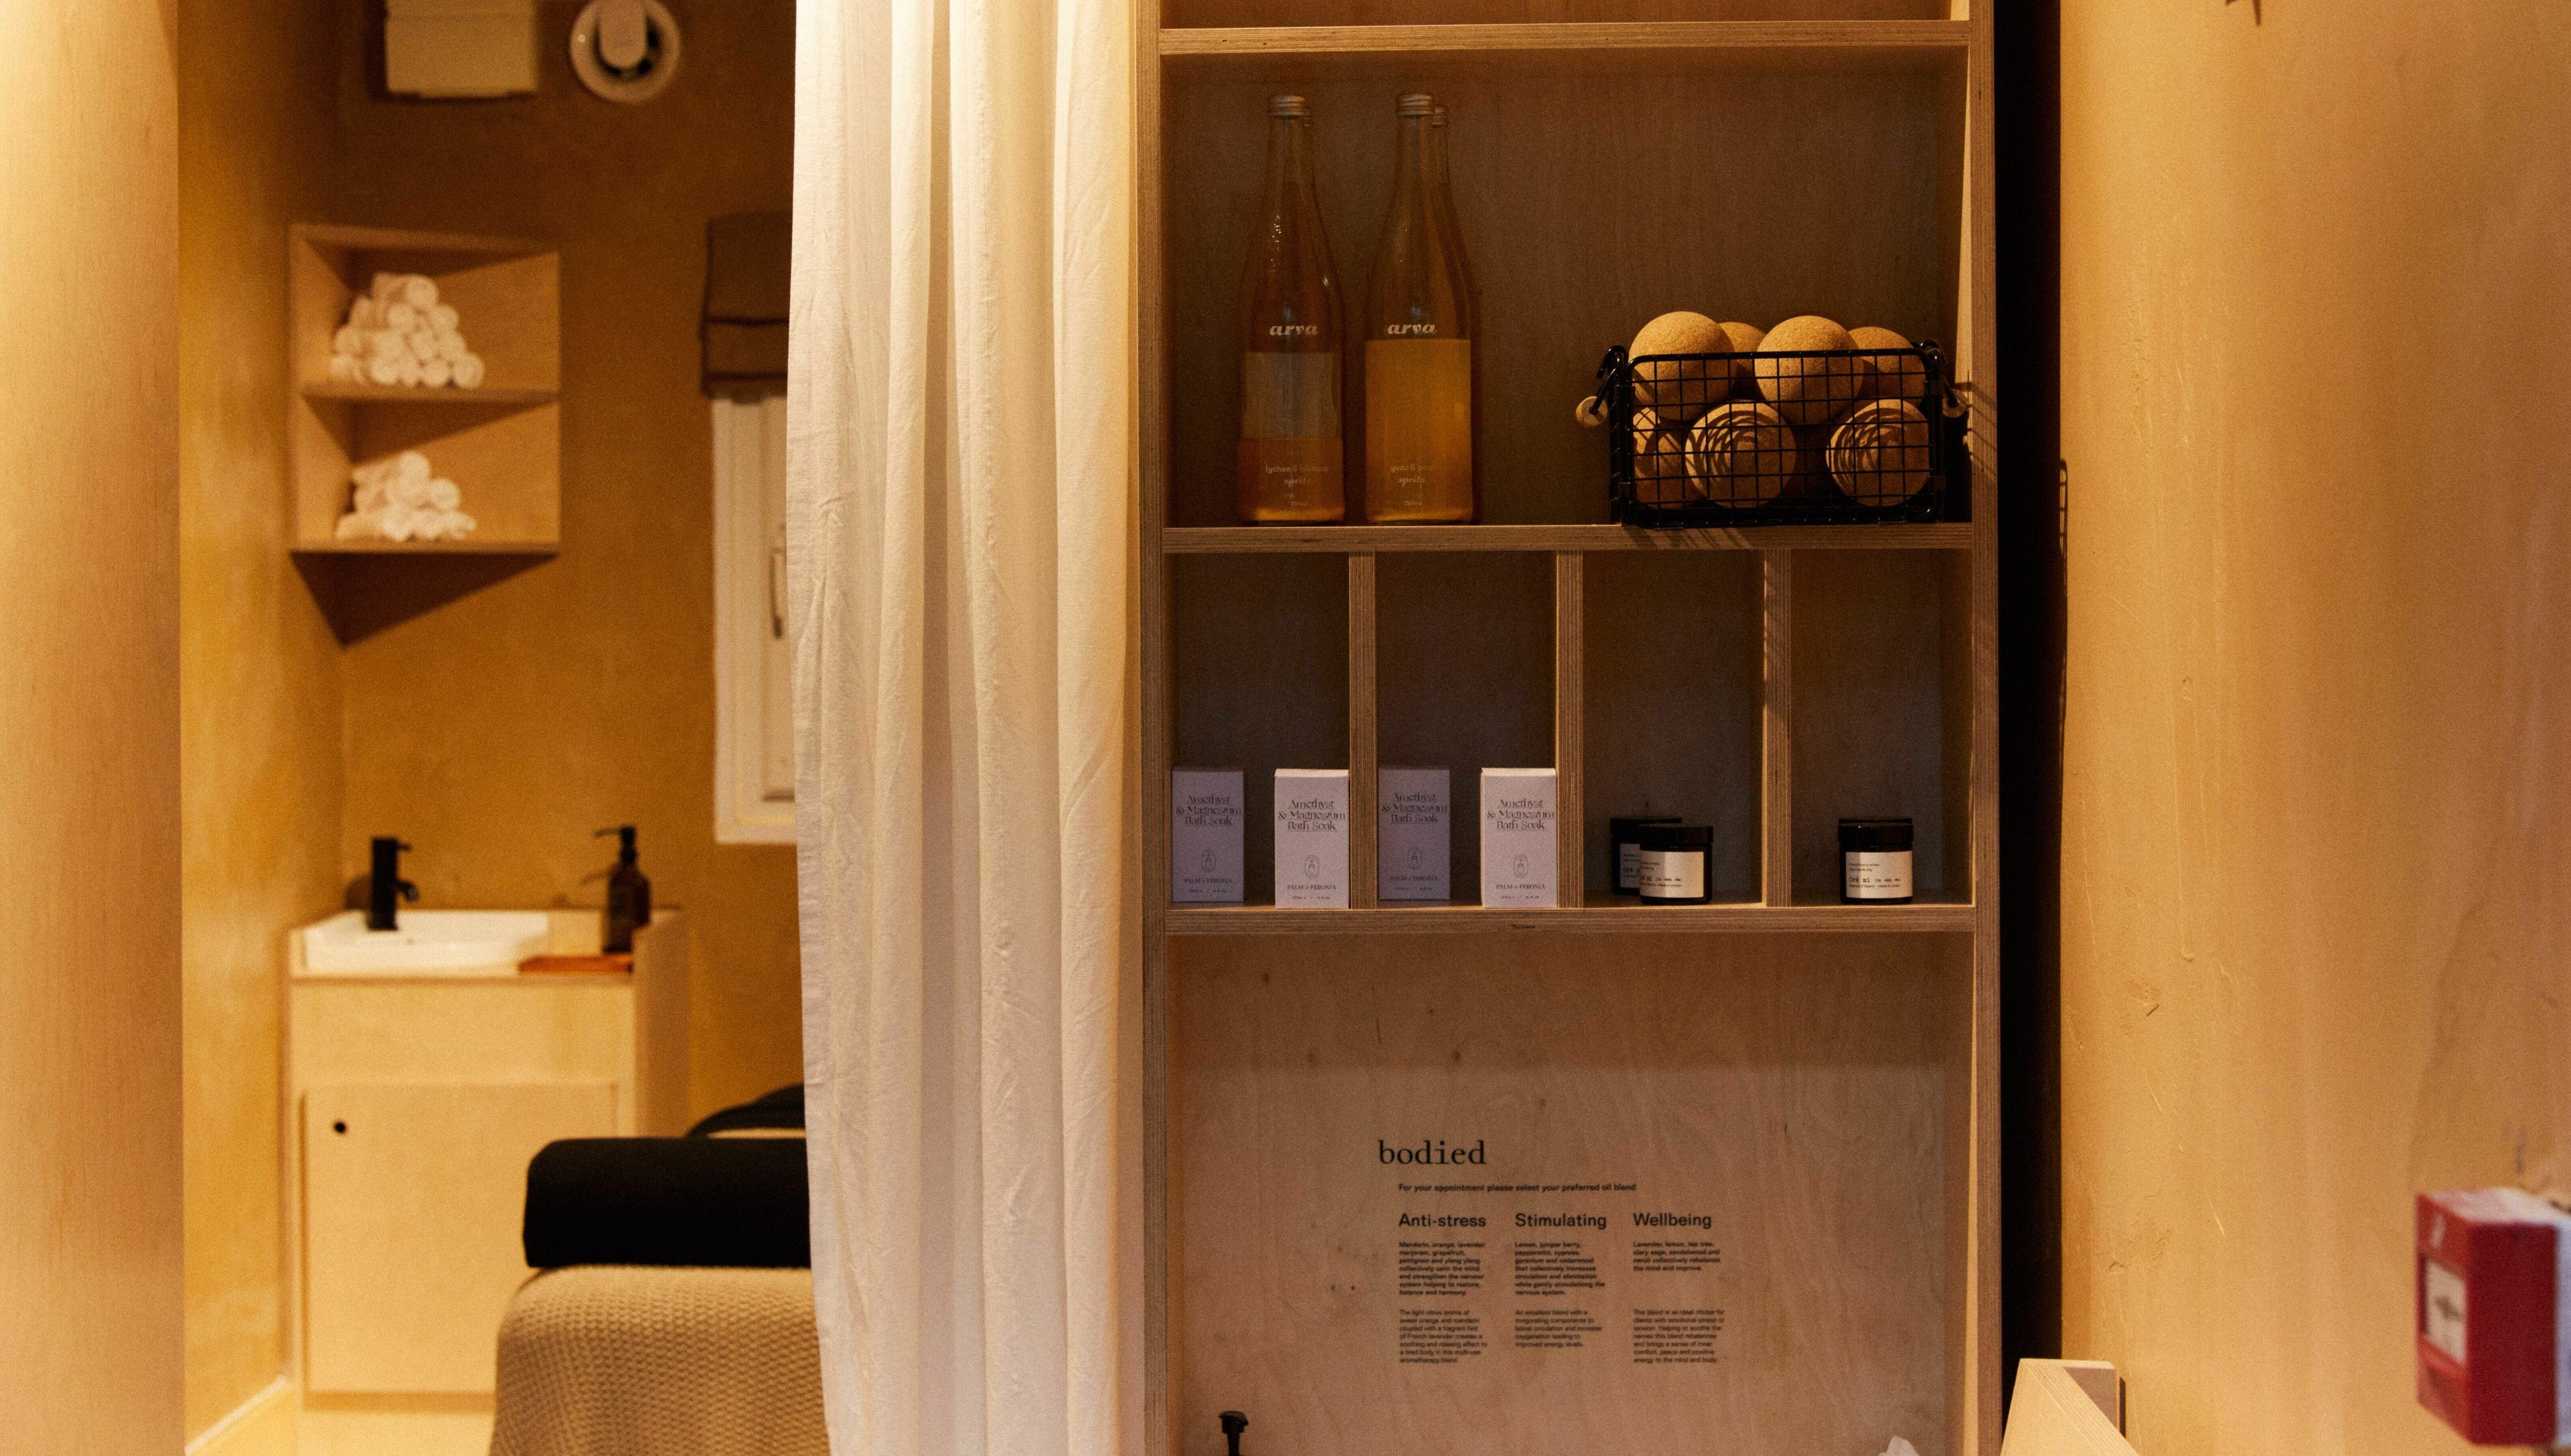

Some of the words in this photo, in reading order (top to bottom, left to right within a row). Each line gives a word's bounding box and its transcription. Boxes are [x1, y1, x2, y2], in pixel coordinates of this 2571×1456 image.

[1269, 325, 1319, 335] arva
[1387, 323, 1437, 335] arva
[1289, 799, 1334, 809] Amethyst
[1497, 798, 1543, 809] Amethyst
[1288, 821, 1309, 830] Bath
[1312, 821, 1336, 830] Soak
[1496, 820, 1518, 829] Bath
[1521, 820, 1545, 829] Soak
[1379, 1139, 1487, 1165] bodied
[1435, 1184, 1484, 1192] appointment
[1487, 1184, 1513, 1192] please
[1562, 1184, 1600, 1192] preferred
[1399, 1213, 1487, 1227] Anti-stress
[1515, 1213, 1607, 1230] Stimulating
[1633, 1213, 1712, 1229] Wellbeing
